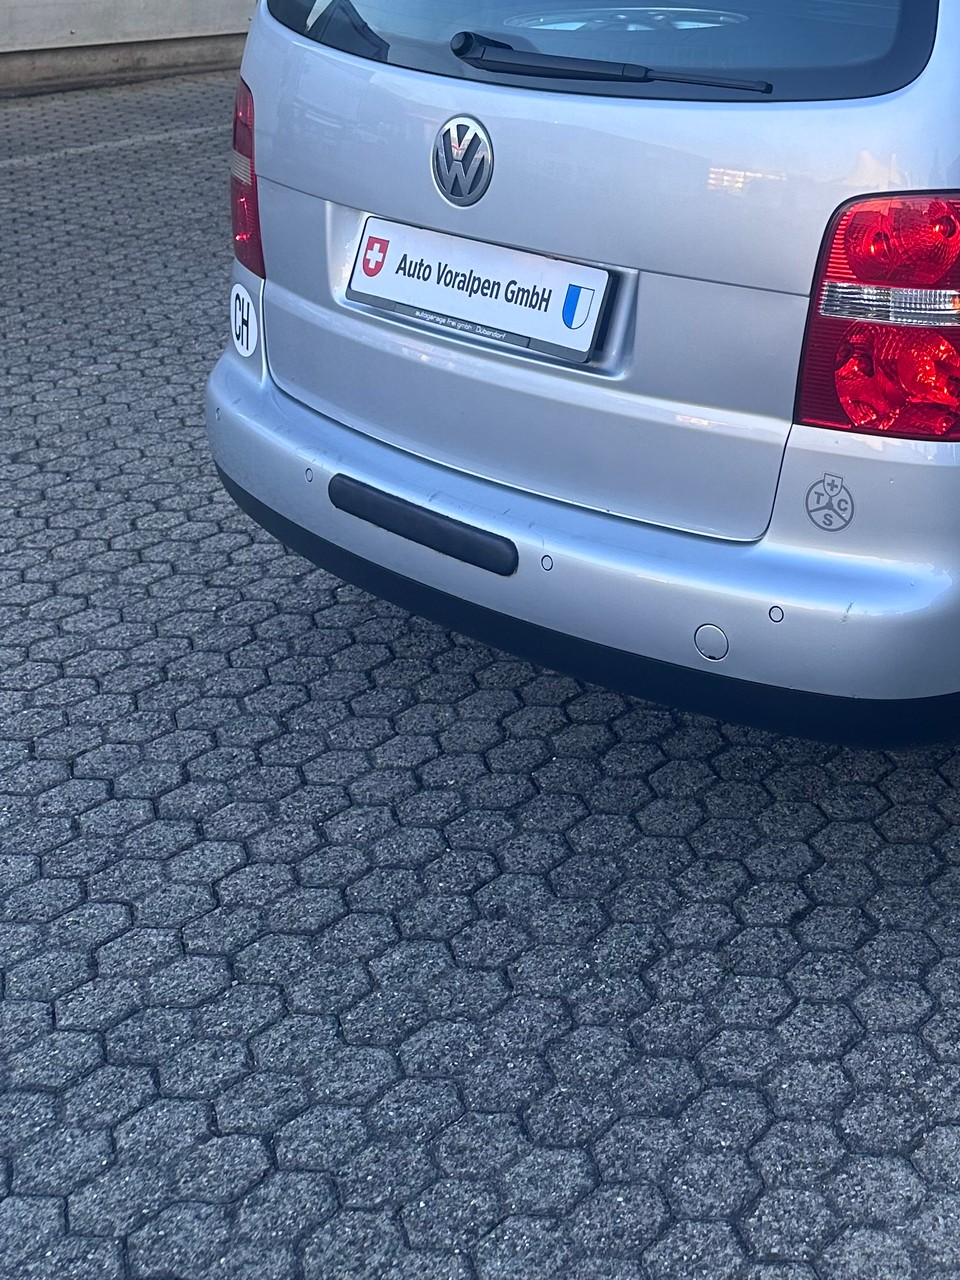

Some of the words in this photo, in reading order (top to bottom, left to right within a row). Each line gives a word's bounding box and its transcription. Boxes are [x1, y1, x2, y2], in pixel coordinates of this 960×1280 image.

[434, 116, 492, 206] VW
[395, 253, 432, 282] Auto
[436, 261, 501, 298] Voralpen
[504, 279, 552, 313] GmbH
[234, 292, 250, 351] CH
[414, 310, 446, 325] autogarage
[446, 317, 457, 327] frei
[456, 322, 473, 331] gmbh
[475, 325, 506, 340] Dübendorf
